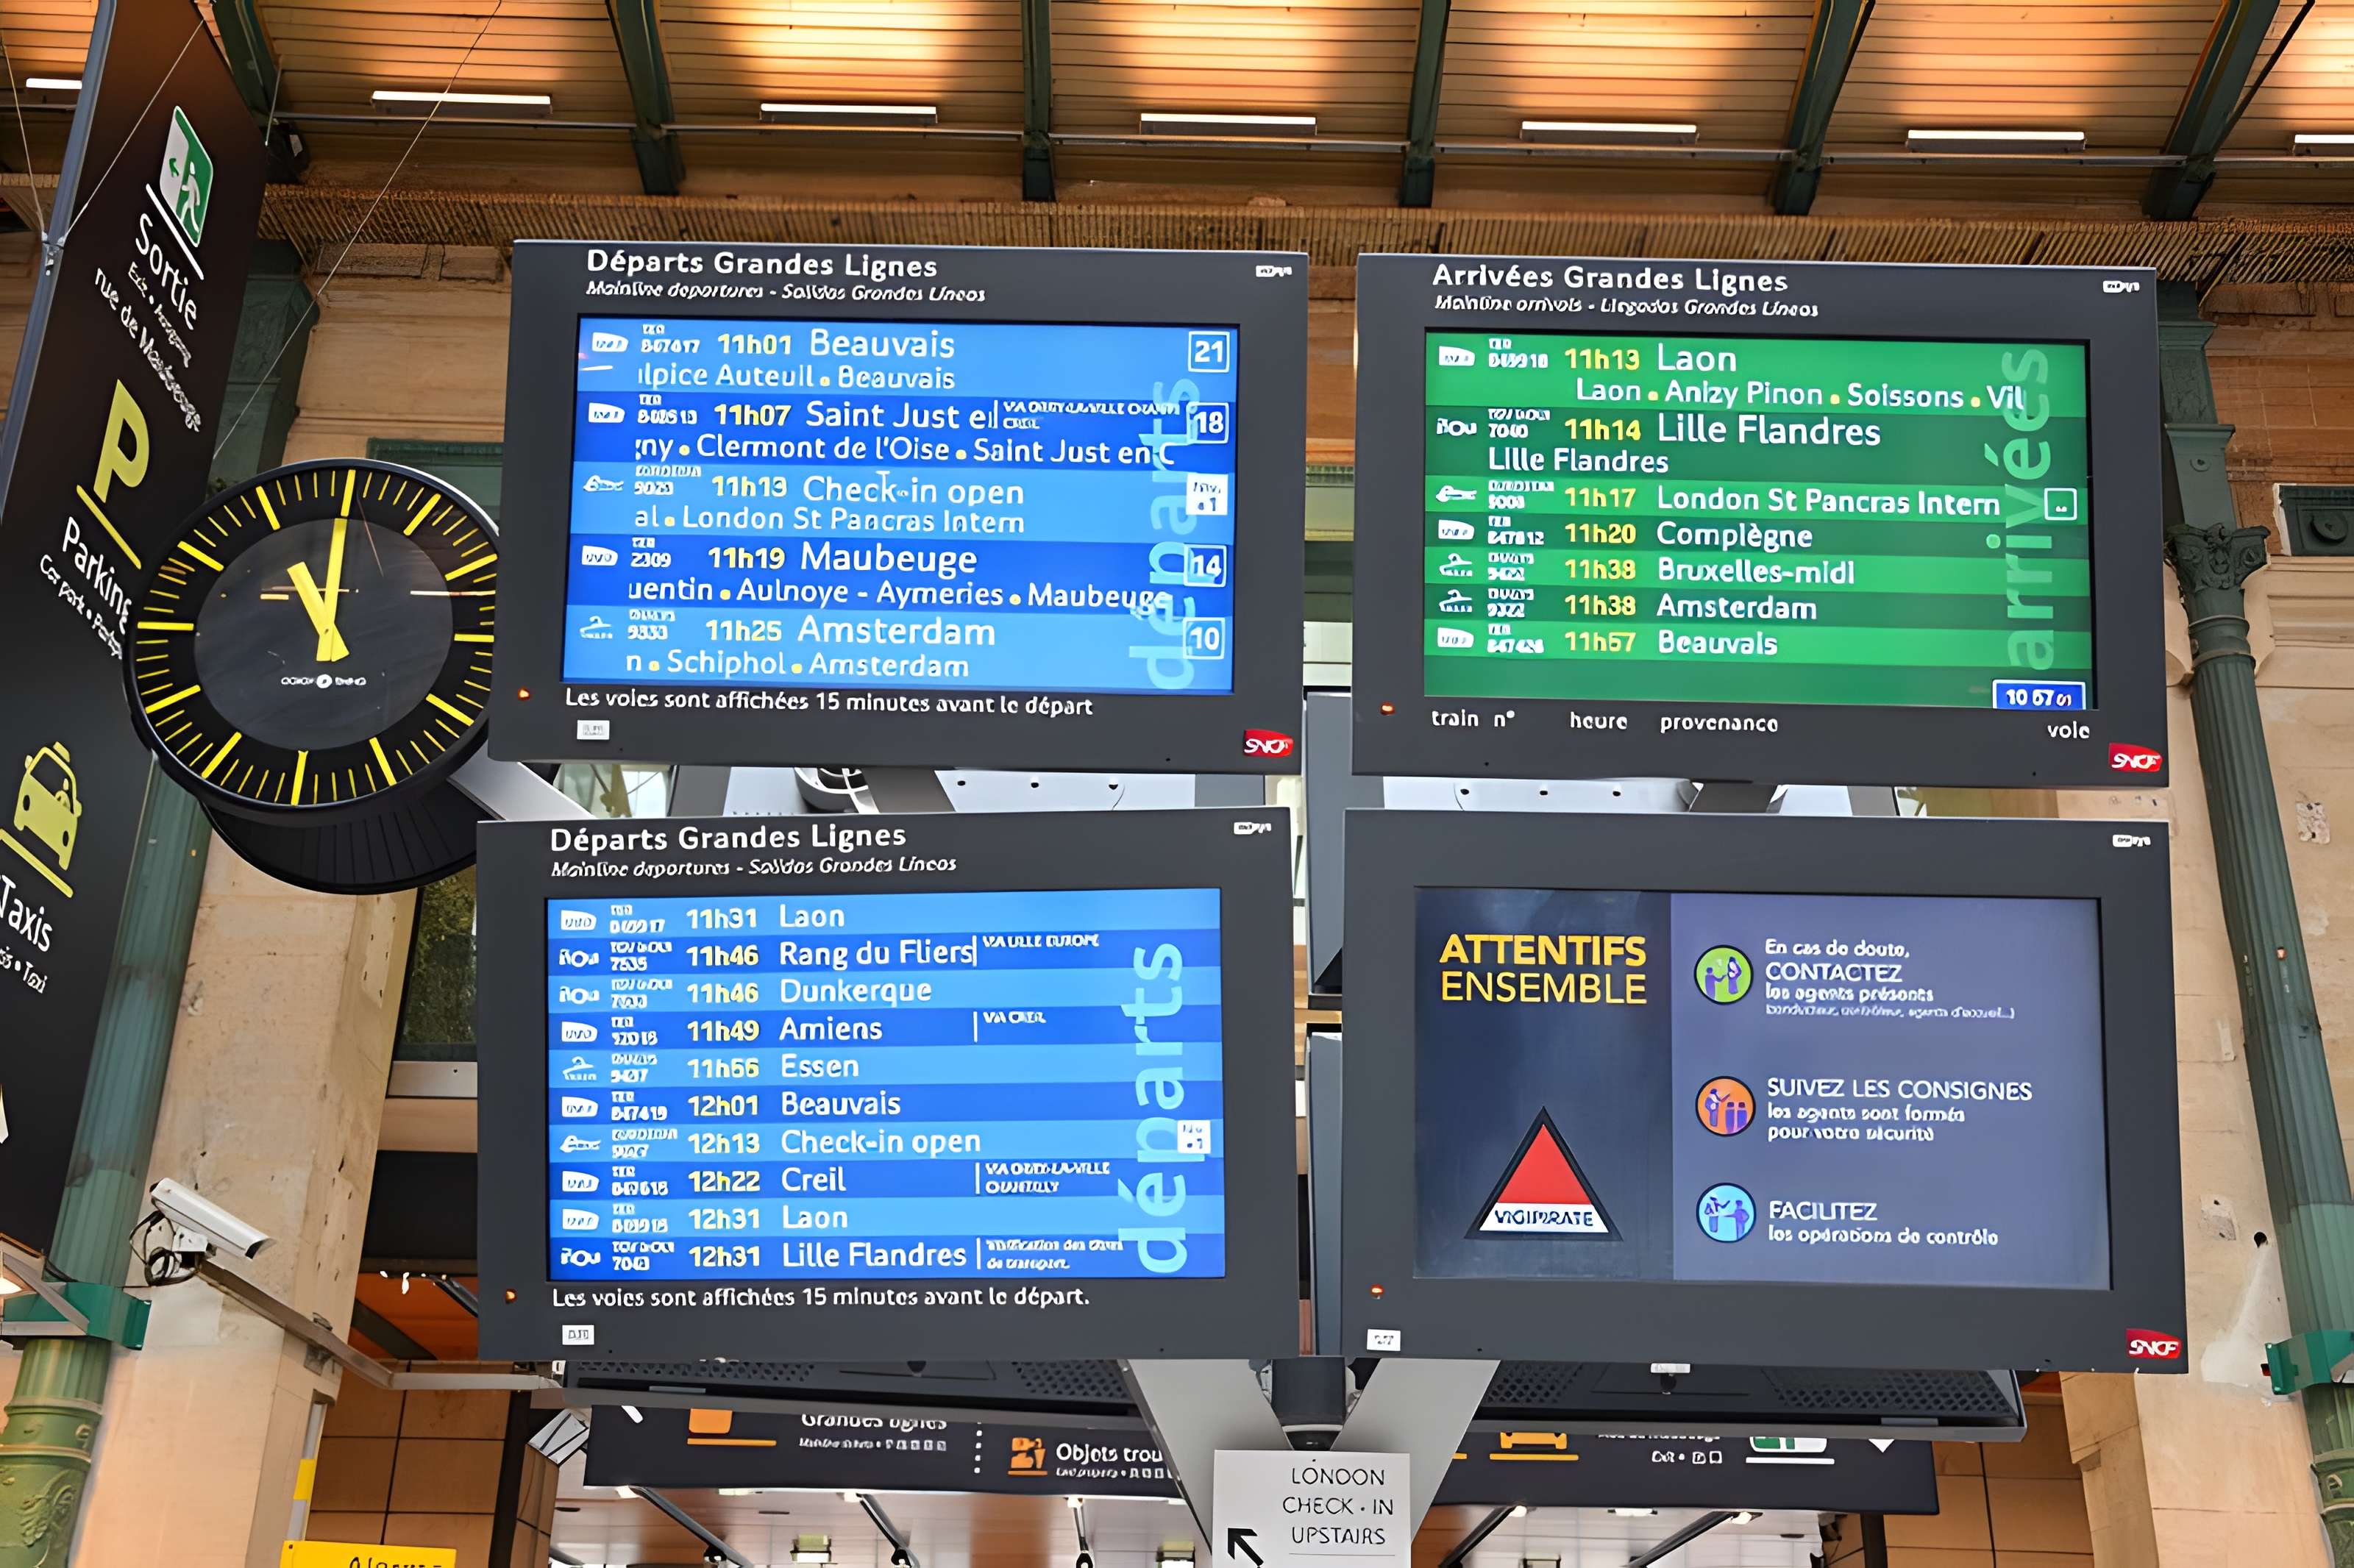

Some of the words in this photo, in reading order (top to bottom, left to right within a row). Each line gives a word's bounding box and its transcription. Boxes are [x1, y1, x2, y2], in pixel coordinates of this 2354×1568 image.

[135, 213, 198, 330] Sortie
[587, 248, 704, 277] Départs
[714, 251, 833, 276] Grandes
[845, 253, 937, 282] Lignes
[1432, 263, 1554, 288] Arrivées
[1564, 266, 1684, 290] Grandes
[1696, 268, 1788, 297] Lignes
[717, 333, 792, 355] 11h01
[810, 328, 955, 359] Beauvais
[1195, 342, 1223, 363] 21
[1565, 348, 1640, 371] 11h13
[1658, 343, 1737, 372] Laon
[715, 363, 814, 388] Auteuil
[838, 364, 956, 390] Beauvais
[1576, 377, 1641, 401] Laon
[1747, 380, 1823, 405] Pinon
[1847, 382, 1964, 408] Soissons
[714, 404, 792, 427] 11h07
[806, 400, 884, 427] Saint
[892, 402, 960, 429] Just
[1192, 411, 1224, 433] 18
[1565, 418, 1641, 441] 11h14
[1659, 412, 1727, 443] Lille
[1738, 414, 1881, 446] Flandres
[697, 433, 825, 459] Clermont
[833, 435, 867, 461] de
[875, 436, 950, 460] l'Oise
[973, 438, 1044, 463] Saint
[1050, 438, 1111, 463] Just
[1117, 446, 1151, 464] en
[1489, 446, 1545, 471] Lille
[1554, 447, 1669, 474] Flandres
[711, 475, 787, 497] 11h13
[803, 477, 937, 503] Check-in
[947, 485, 1024, 507] open
[1565, 487, 1637, 507] 11h17
[1658, 485, 1760, 510] London
[1768, 488, 1798, 512] St
[1806, 488, 1910, 514] Pancras
[683, 505, 783, 530] London
[793, 506, 822, 530] St
[831, 507, 935, 532] Pancras
[1565, 523, 1637, 544] 11h20
[708, 546, 785, 570] 11h19
[800, 541, 977, 580] Maubeuge
[1192, 555, 1221, 576] 14
[1565, 558, 1636, 580] 11h38
[1658, 556, 1855, 585] Bruxelles-midi
[736, 577, 848, 609] Aulnoye
[876, 580, 1003, 610] Aymeries
[1028, 583, 1173, 616] Maubeuge
[1565, 594, 1636, 616] 11h38
[1656, 593, 1817, 620] Amsterdam
[705, 619, 782, 641] 11h25
[797, 614, 995, 646] Amsterdam
[1190, 627, 1220, 649] 10
[1658, 629, 1778, 655] Beauvais
[626, 655, 641, 671] n
[667, 649, 786, 680] Schiphol
[808, 652, 969, 677] Amsterdam
[566, 687, 600, 707] Les
[664, 692, 711, 708] sont
[715, 690, 809, 710] affichées
[816, 691, 840, 710] 15
[846, 692, 931, 713] minutes
[936, 698, 995, 713] avant
[1000, 695, 1019, 713] le
[2006, 688, 2028, 706] 10
[1432, 708, 1479, 727] train
[1570, 711, 1628, 730] heure
[551, 827, 667, 857] Départs
[678, 824, 800, 850] Grandes
[811, 823, 906, 853] Lignes
[686, 907, 757, 930] 11h31
[780, 904, 844, 928] Laon
[686, 944, 759, 966] 11h46
[780, 941, 848, 972] Rang
[856, 940, 889, 965] du
[899, 938, 974, 963] Fliers
[1439, 933, 1646, 967] ATTENTIFS
[1765, 938, 1788, 955] En
[1792, 943, 1821, 955] cas
[1766, 961, 1903, 983] CONTACTEZ
[686, 982, 759, 1004] 11h46
[780, 978, 932, 1008] Dunkerque
[1442, 971, 1648, 1004] ENSEMBLE
[687, 1019, 760, 1041] 11h49
[779, 1016, 883, 1041] Amiens
[781, 1052, 859, 1078] Essen
[1768, 1077, 1845, 1097] SUIVEZ
[1852, 1079, 1891, 1098] LES
[1897, 1080, 2033, 1101] CONSIGNES
[688, 1094, 758, 1116] 12h01
[782, 1090, 901, 1116] Beauvais
[688, 1132, 760, 1154] 12h13
[781, 1128, 903, 1154] Check-in
[911, 1134, 981, 1159] open
[1768, 1126, 1810, 1142] pour
[688, 1170, 761, 1192] 12h22
[781, 1166, 847, 1191] Creil
[688, 1208, 760, 1230] 12h31
[783, 1205, 848, 1229] Laon
[1769, 1200, 1878, 1222] FACILITEZ
[1768, 1224, 1793, 1241] les
[1897, 1227, 1921, 1244] de
[1926, 1228, 1999, 1246] contrôle
[689, 1245, 760, 1267] 12h31
[783, 1241, 840, 1268] Lille
[849, 1241, 967, 1266] Flandres
[552, 1288, 586, 1307] Les
[591, 1288, 644, 1307] voies
[650, 1290, 697, 1307] sont
[702, 1287, 795, 1306] affichées
[802, 1287, 827, 1305] 15
[833, 1286, 918, 1305] minutes
[924, 1289, 984, 1305] avant
[989, 1286, 1007, 1305] le
[2129, 1339, 2179, 1355] SNCF
[1292, 1467, 1384, 1486] LONDON
[1292, 1526, 1386, 1545] UPSTAIRS
